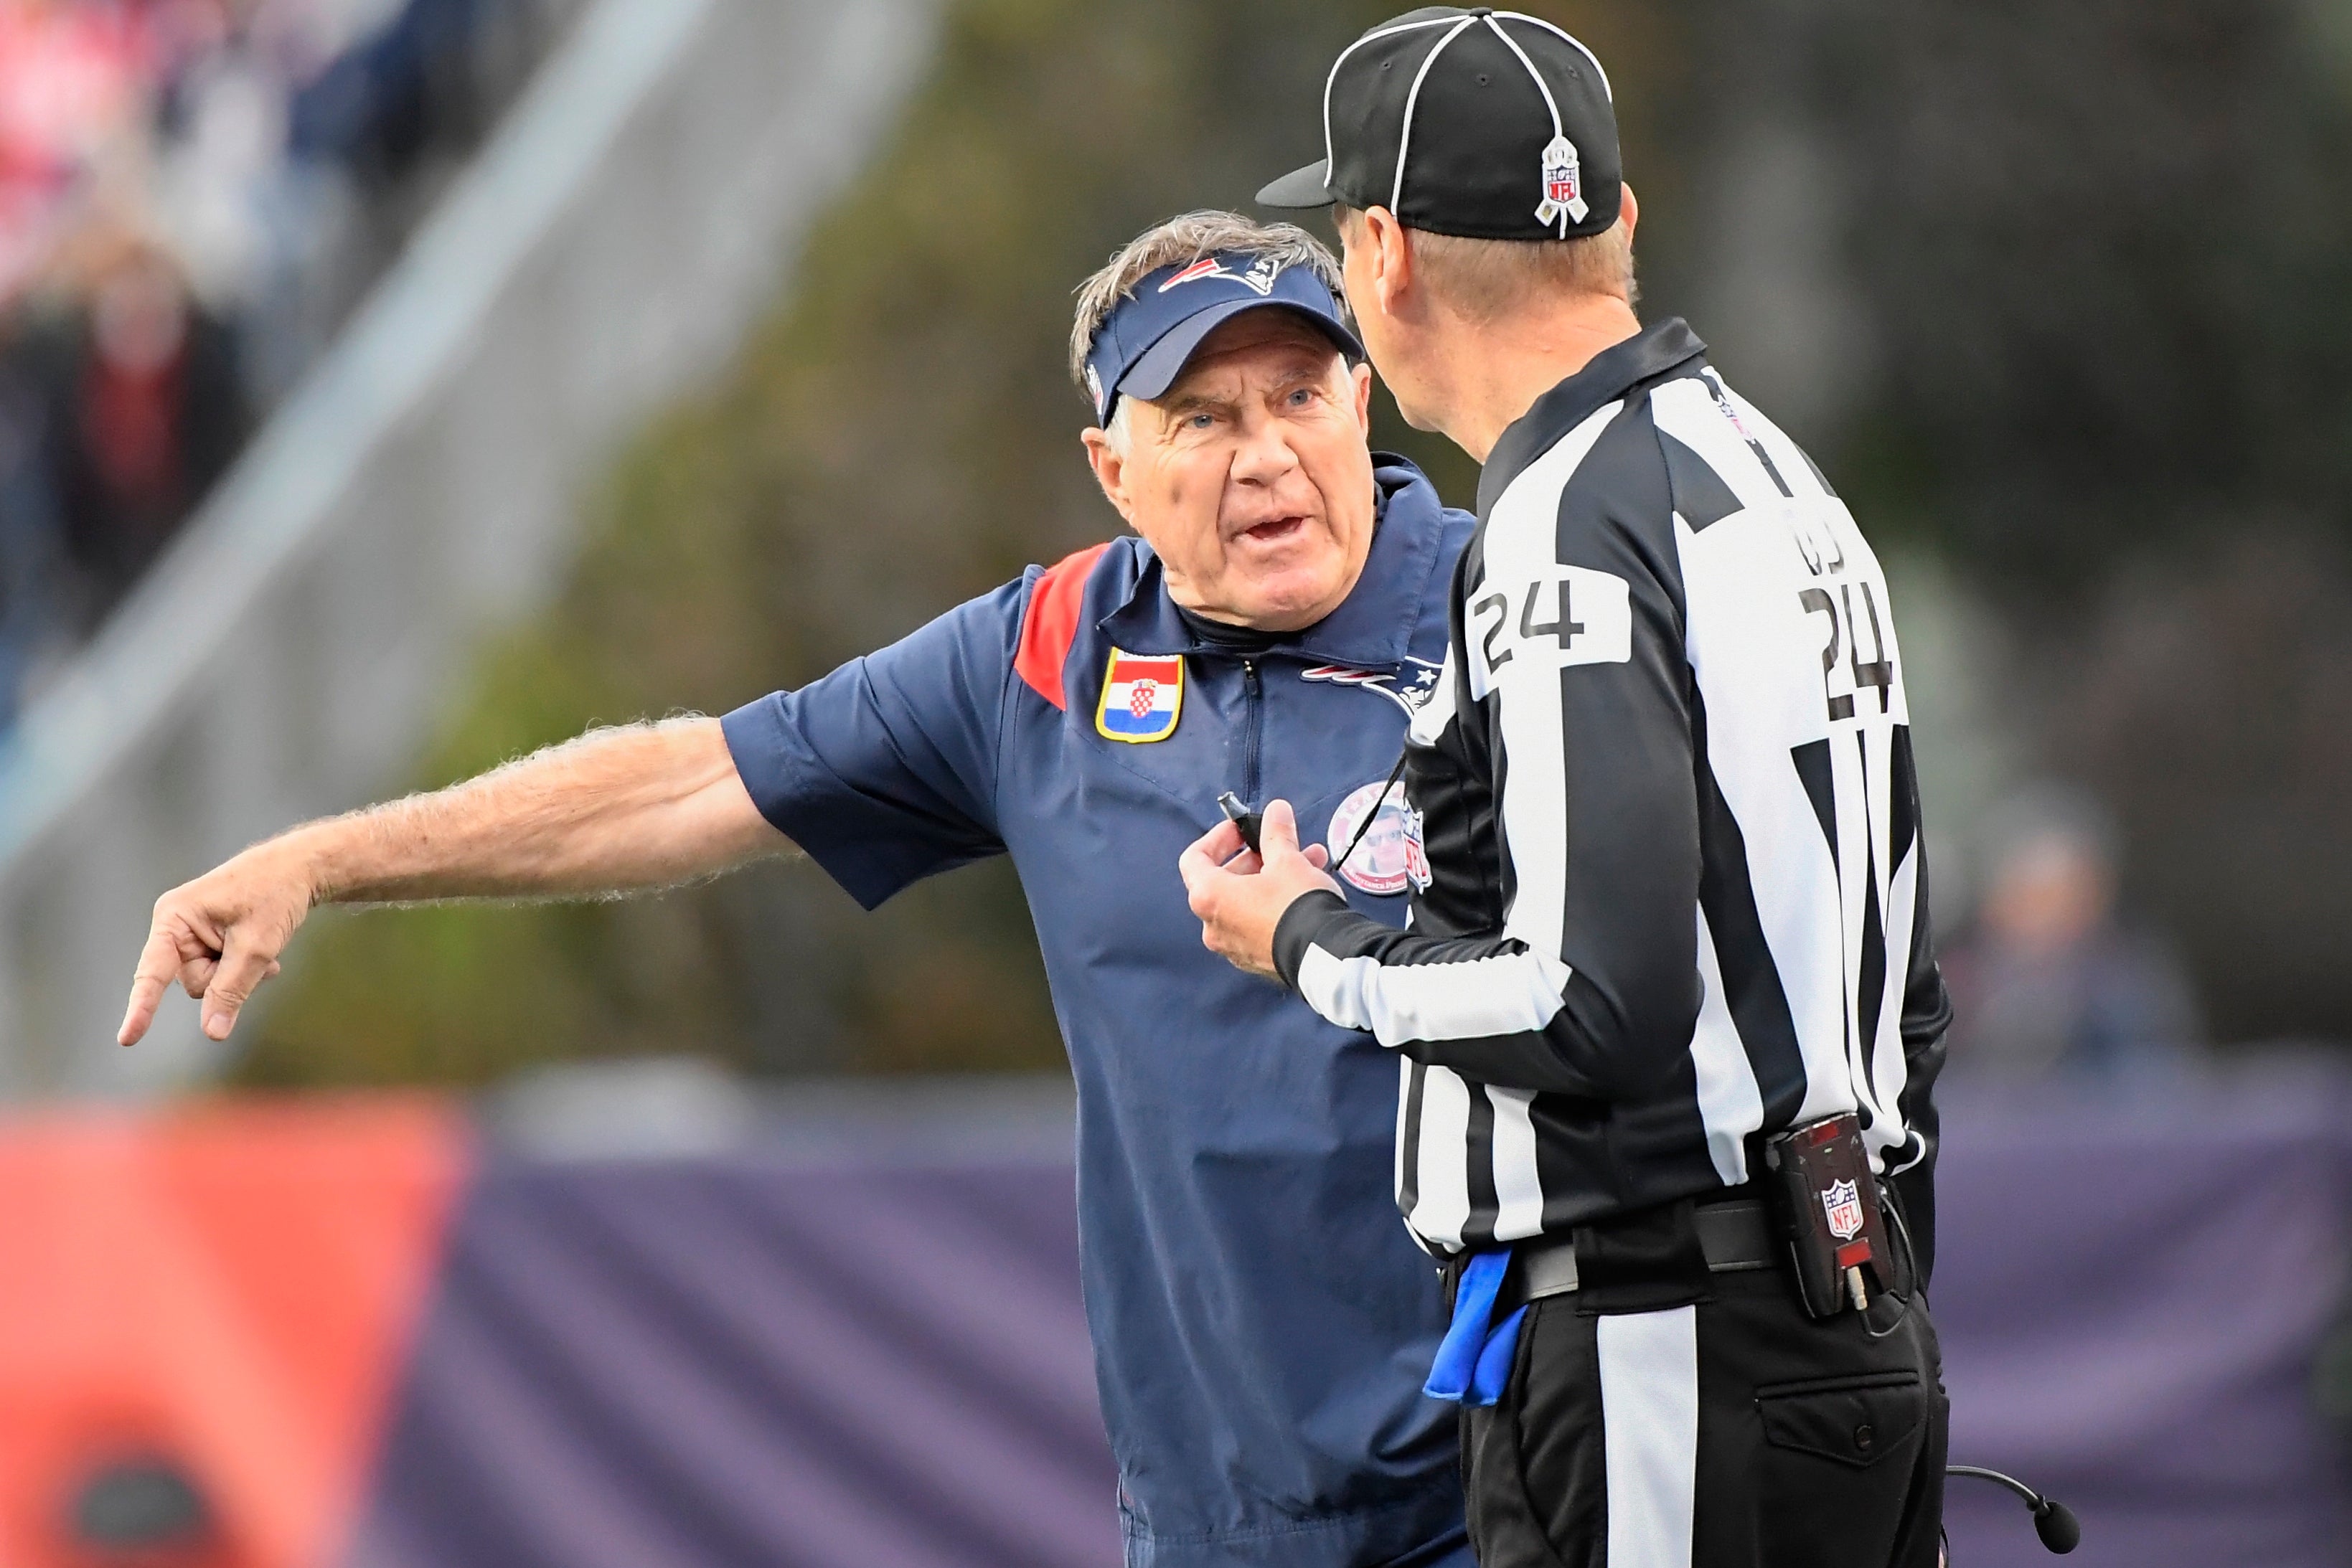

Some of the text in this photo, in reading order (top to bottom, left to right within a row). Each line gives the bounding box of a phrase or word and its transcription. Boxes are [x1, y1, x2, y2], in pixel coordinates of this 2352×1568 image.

[1551, 183, 1575, 200] NFL
[1473, 580, 1584, 676] 24
[1797, 582, 1893, 722] 24
[1832, 1205, 1858, 1230] NFL
